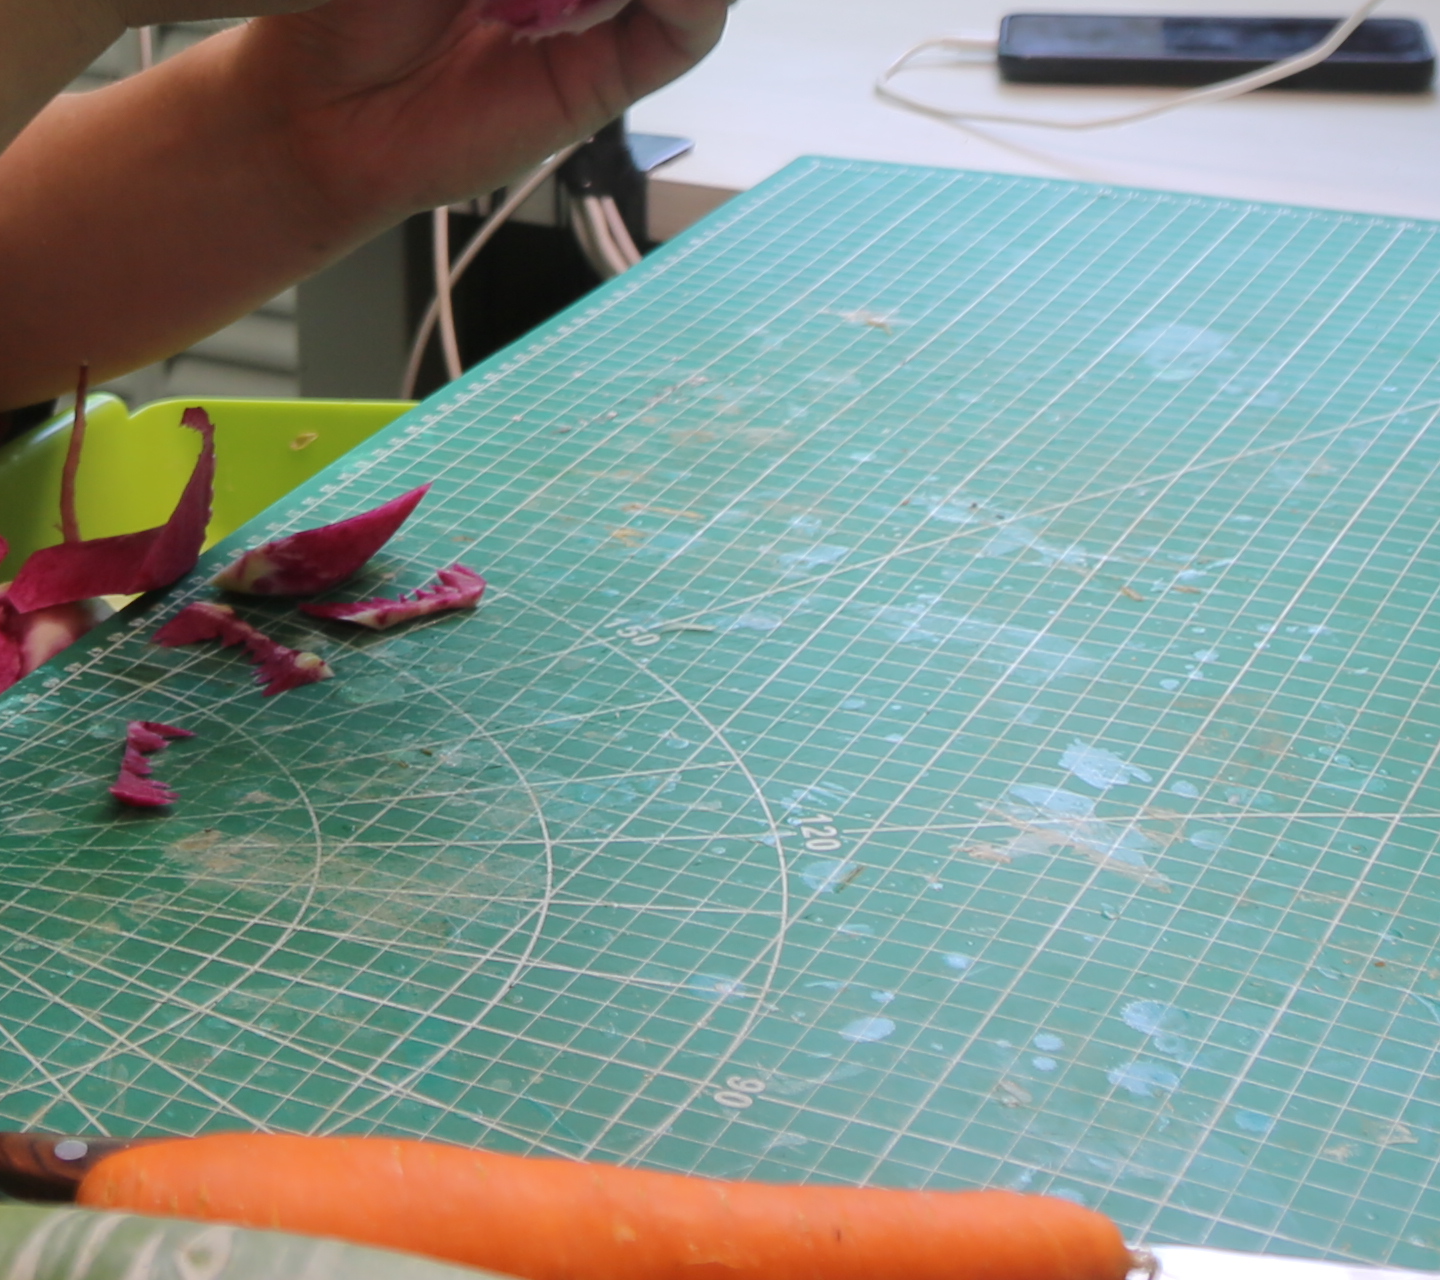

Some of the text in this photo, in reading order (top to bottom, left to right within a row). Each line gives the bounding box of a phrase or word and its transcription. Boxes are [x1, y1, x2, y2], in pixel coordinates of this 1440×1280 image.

[604, 618, 660, 646] 150
[800, 814, 841, 850] 120
[714, 1076, 766, 1108] 90
